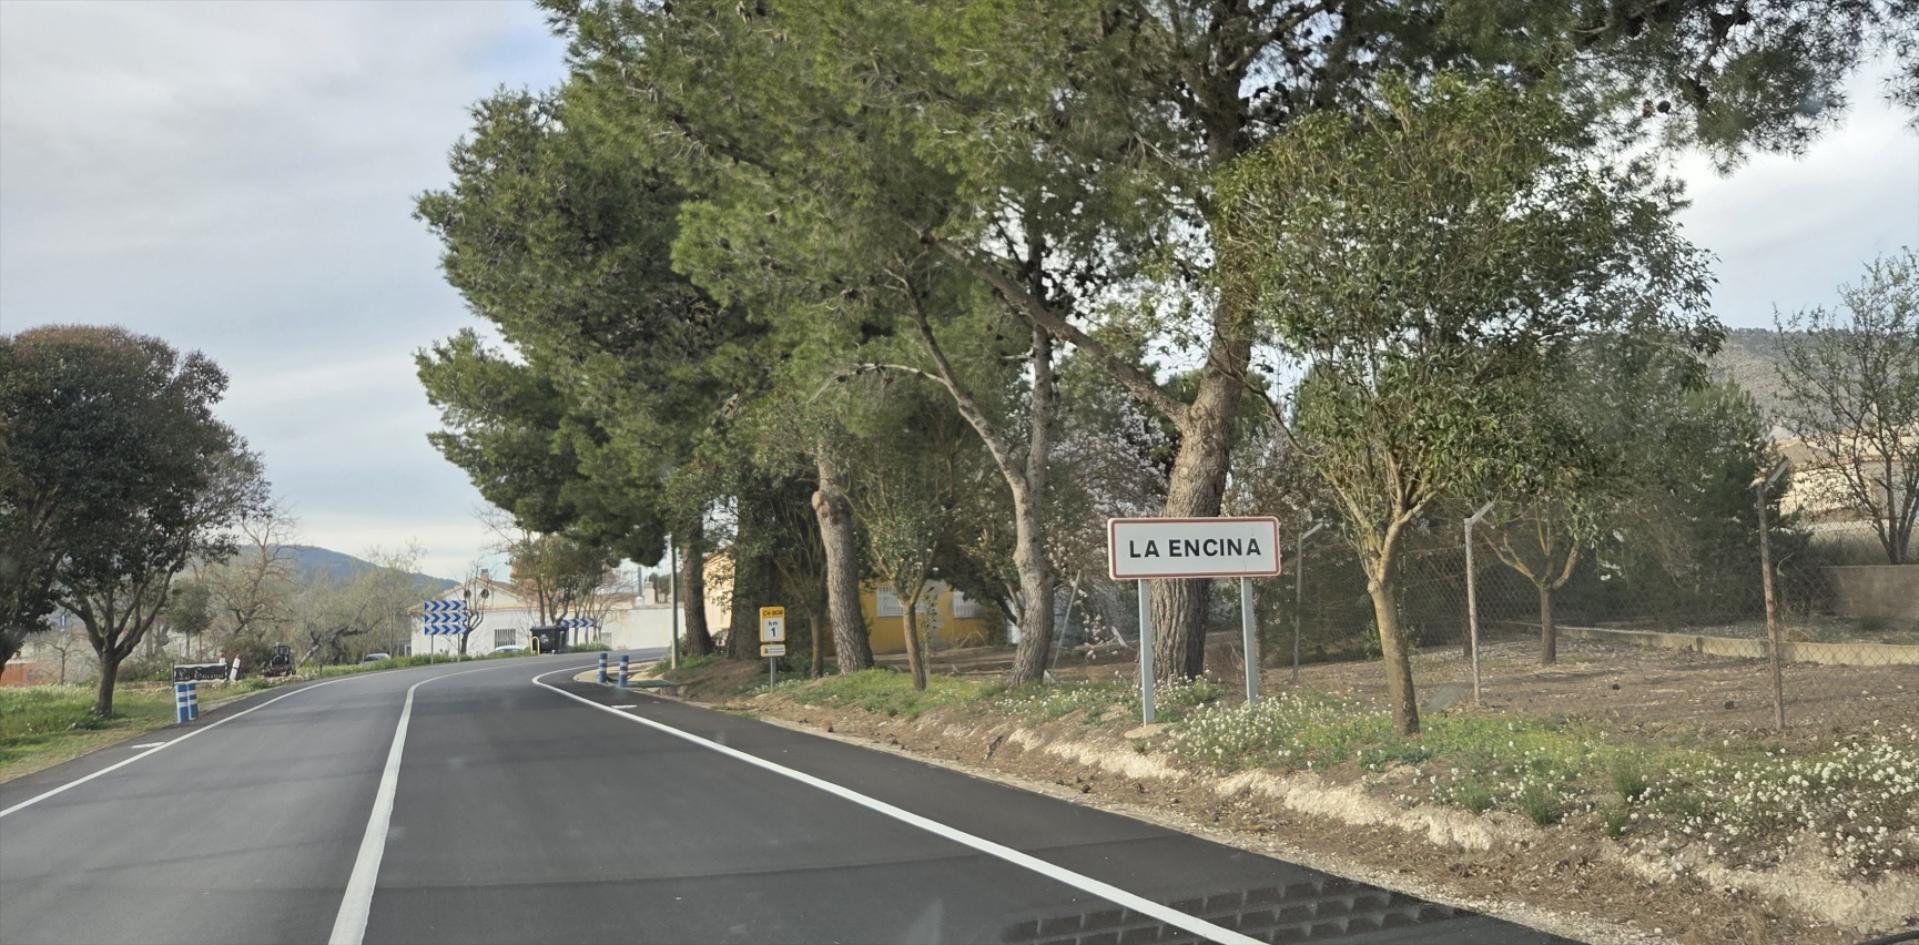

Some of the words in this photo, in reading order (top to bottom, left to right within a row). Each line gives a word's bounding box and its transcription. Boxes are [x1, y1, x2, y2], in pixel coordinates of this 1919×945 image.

[1129, 540, 1160, 558] LA
[1168, 538, 1262, 558] ENCINA
[771, 627, 776, 637] 1
